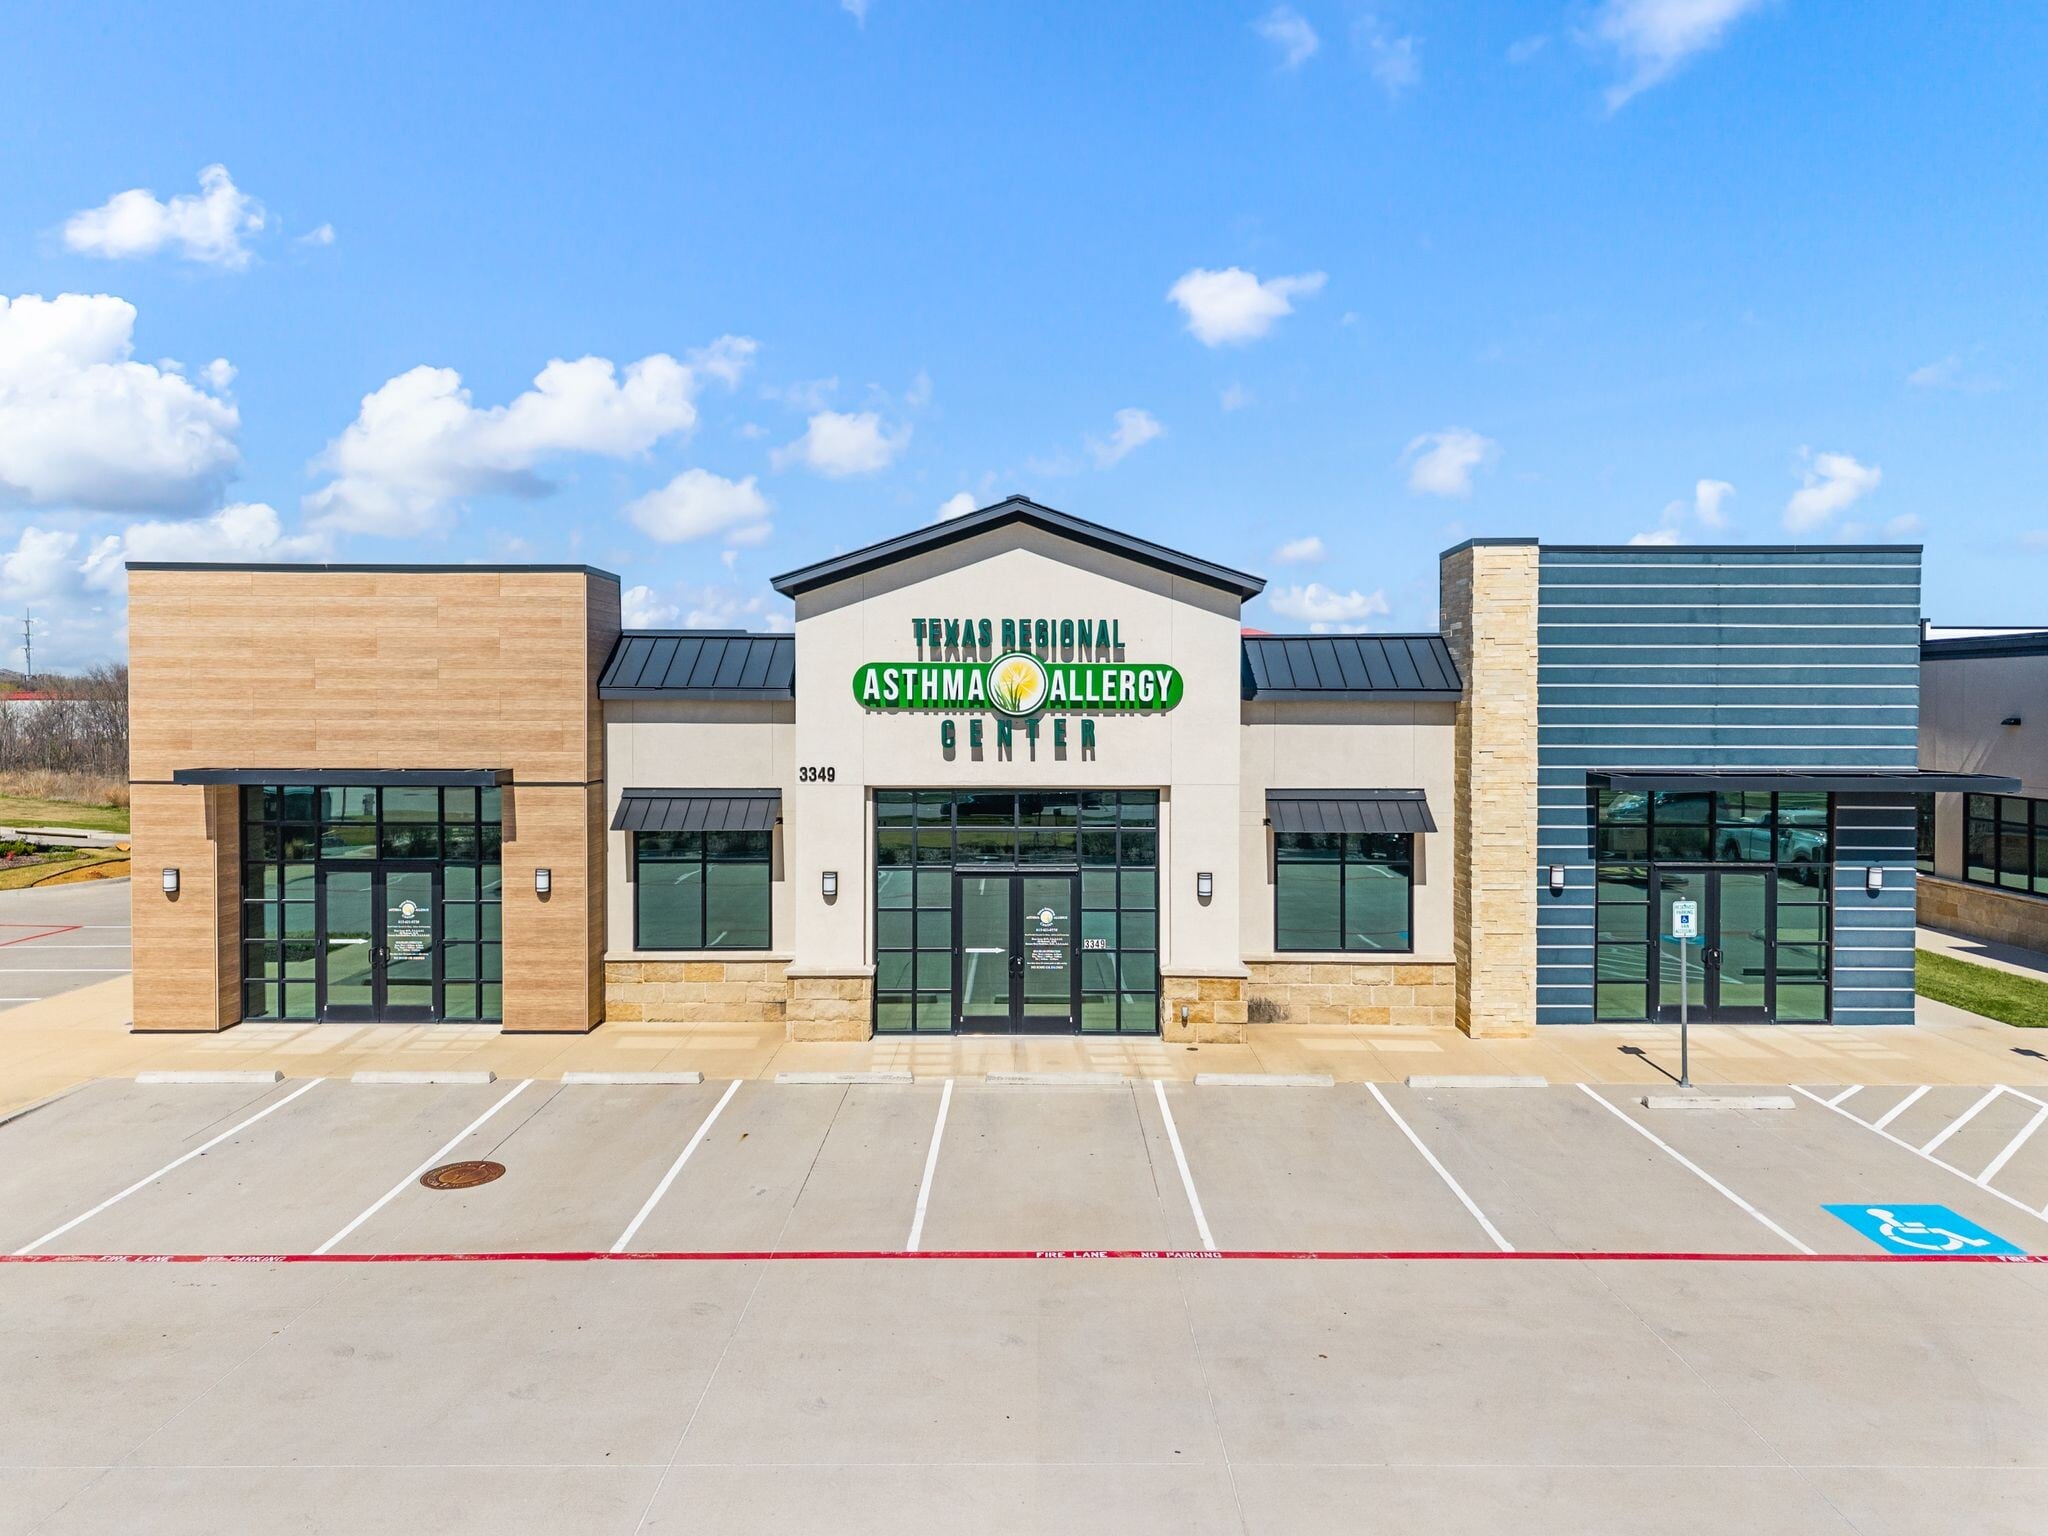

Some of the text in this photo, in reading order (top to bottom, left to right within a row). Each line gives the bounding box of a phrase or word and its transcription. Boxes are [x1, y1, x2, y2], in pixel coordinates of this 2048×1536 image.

[912, 618, 1125, 648] TEXAS REGIONAL
[862, 668, 1173, 702] ASTHMA ALLERGY
[941, 719, 1096, 748] CENTER
[799, 766, 836, 782] 3349
[1085, 939, 1105, 948] 3349
